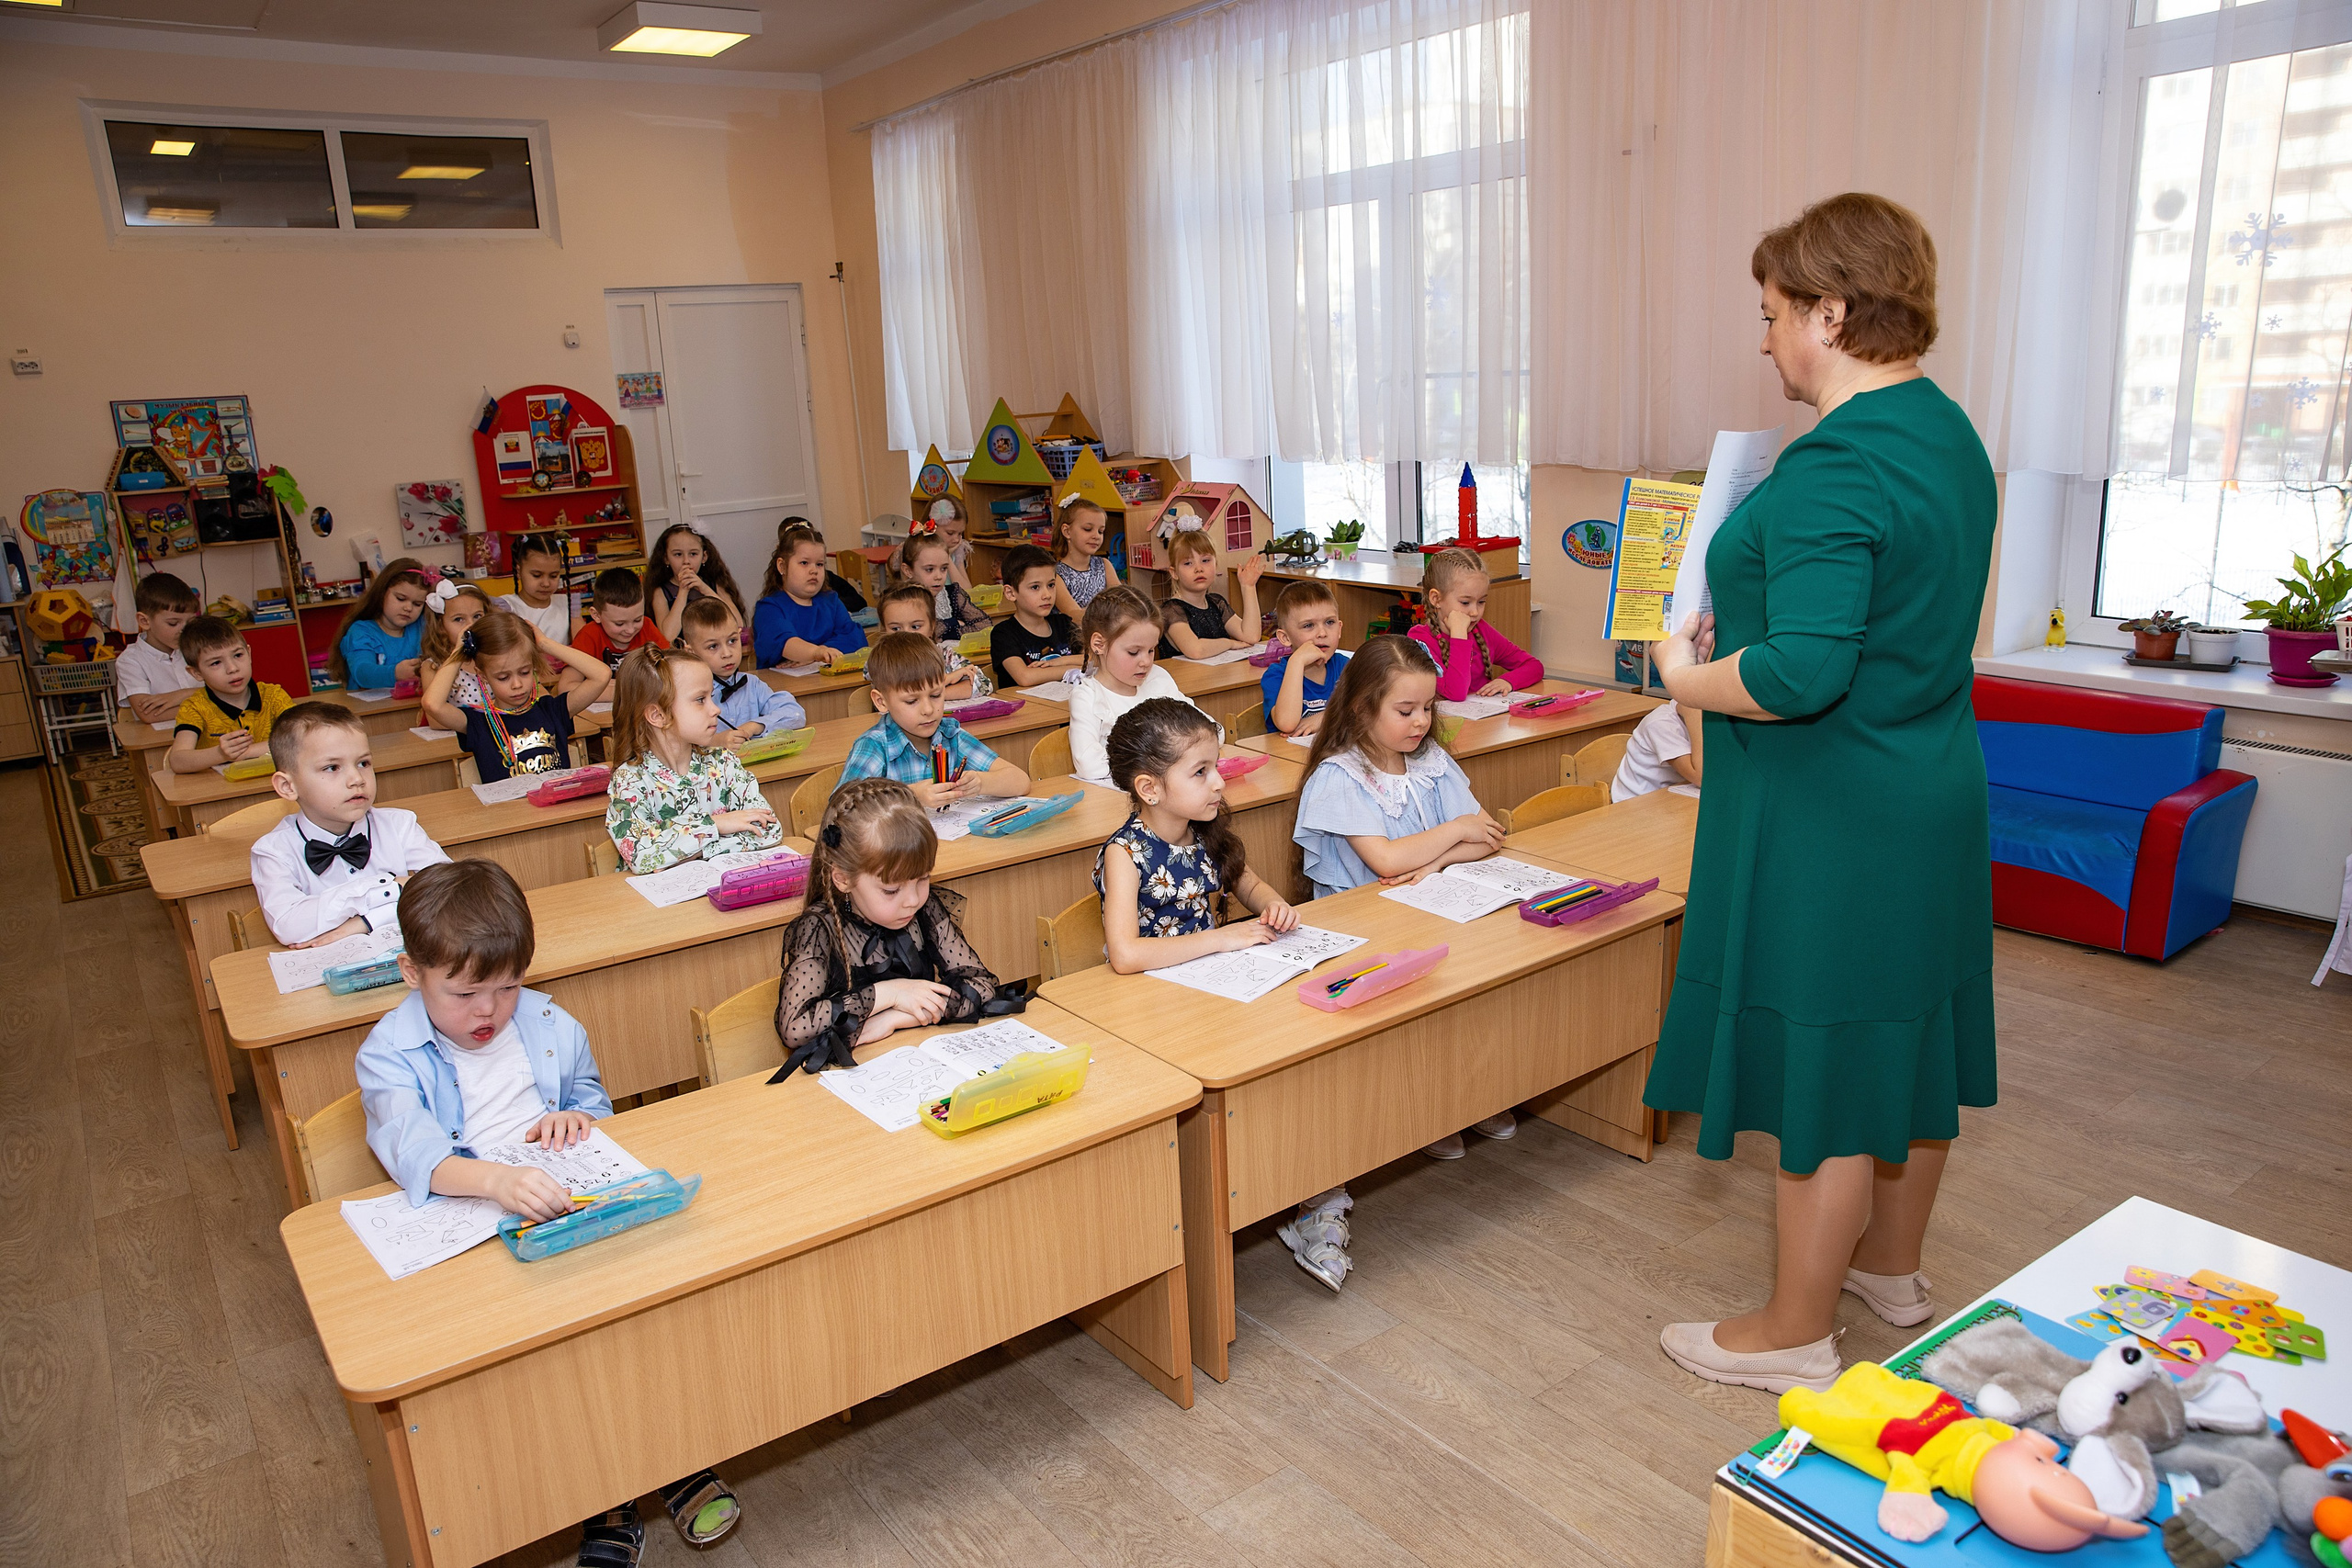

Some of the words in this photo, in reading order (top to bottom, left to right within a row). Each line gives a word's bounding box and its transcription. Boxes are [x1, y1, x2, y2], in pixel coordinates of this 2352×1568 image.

[1655, 489, 1696, 499] МАТЕМАТИЧЕСКОЕ
[1582, 550, 1607, 558] ЮНЫЕ
[1036, 1089, 1063, 1104] РИТА
[2142, 1301, 2172, 1315] 6
